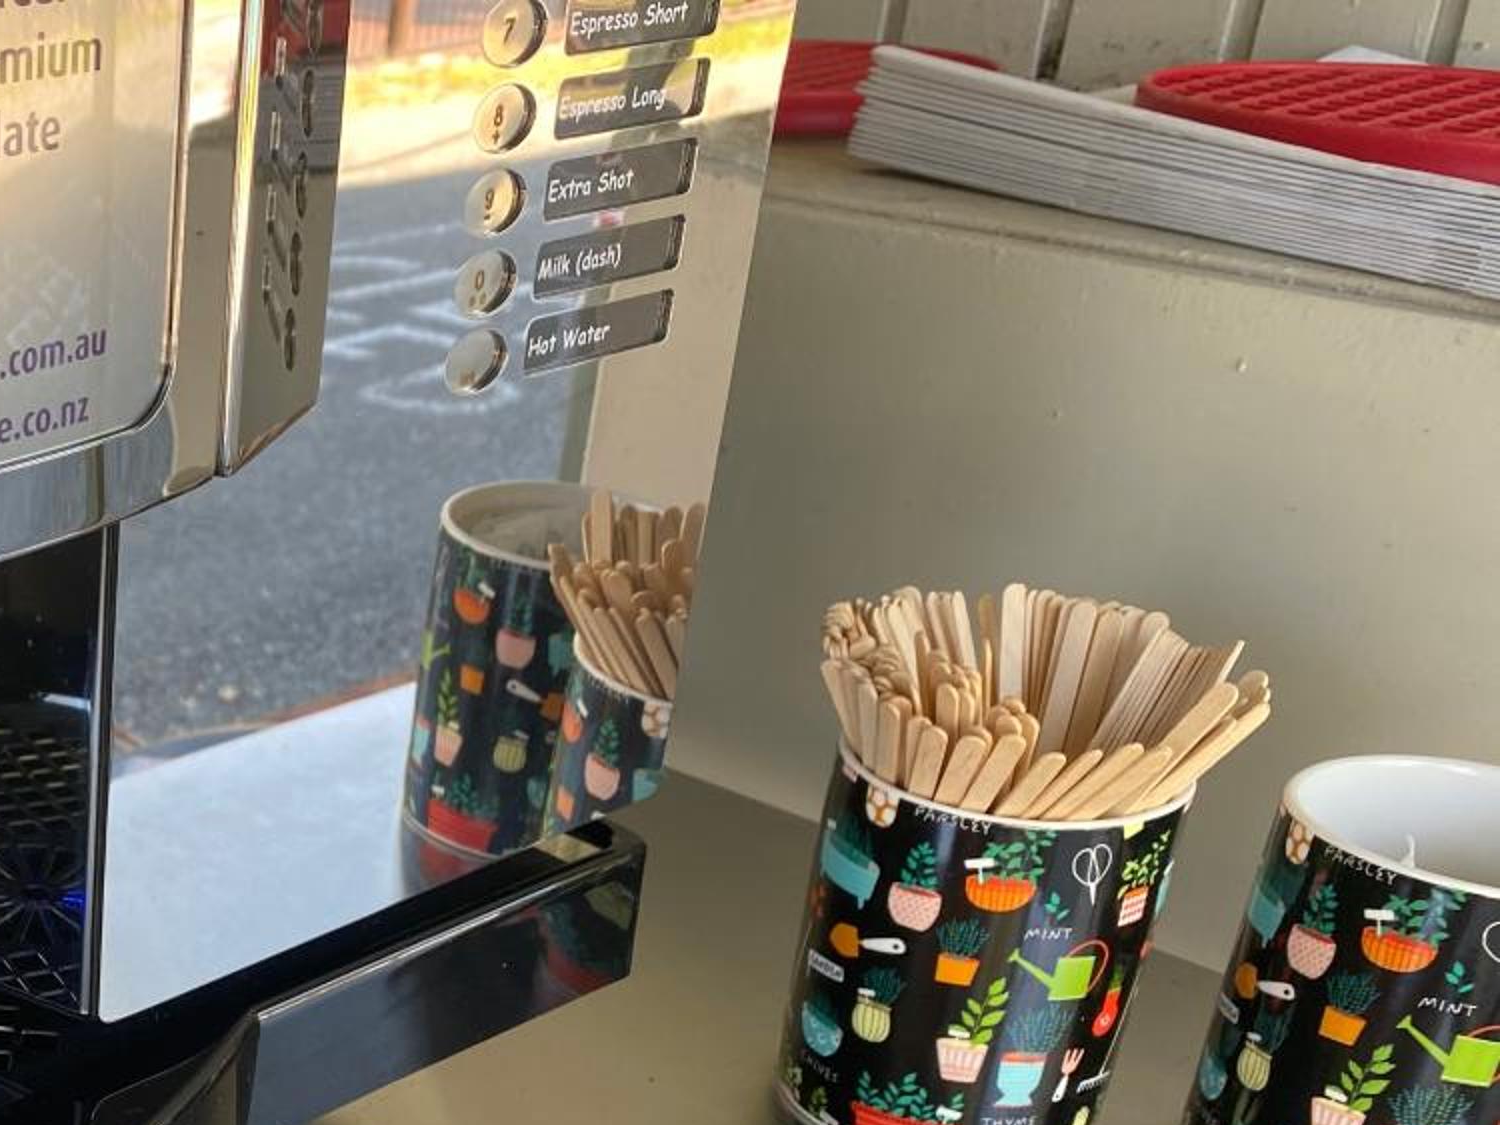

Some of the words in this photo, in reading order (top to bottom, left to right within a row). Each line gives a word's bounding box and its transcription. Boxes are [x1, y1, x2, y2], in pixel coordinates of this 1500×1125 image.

[504, 17, 517, 45] 7
[570, 10, 638, 40] Espresso
[643, 1, 689, 26] Short
[493, 104, 503, 126] 8
[558, 94, 627, 124] Espresso
[631, 85, 667, 112] Long
[485, 187, 495, 210] 9
[548, 178, 592, 203] Extra
[598, 168, 634, 195] Shot
[537, 252, 571, 281] Milk
[575, 243, 623, 276] (dash)
[527, 335, 556, 358] Hot
[563, 324, 611, 349] Water
[914, 805, 992, 836] PARSLEY
[1323, 843, 1400, 886] PARSLEY
[1023, 926, 1073, 941] MINT
[1417, 995, 1479, 1018] MINT
